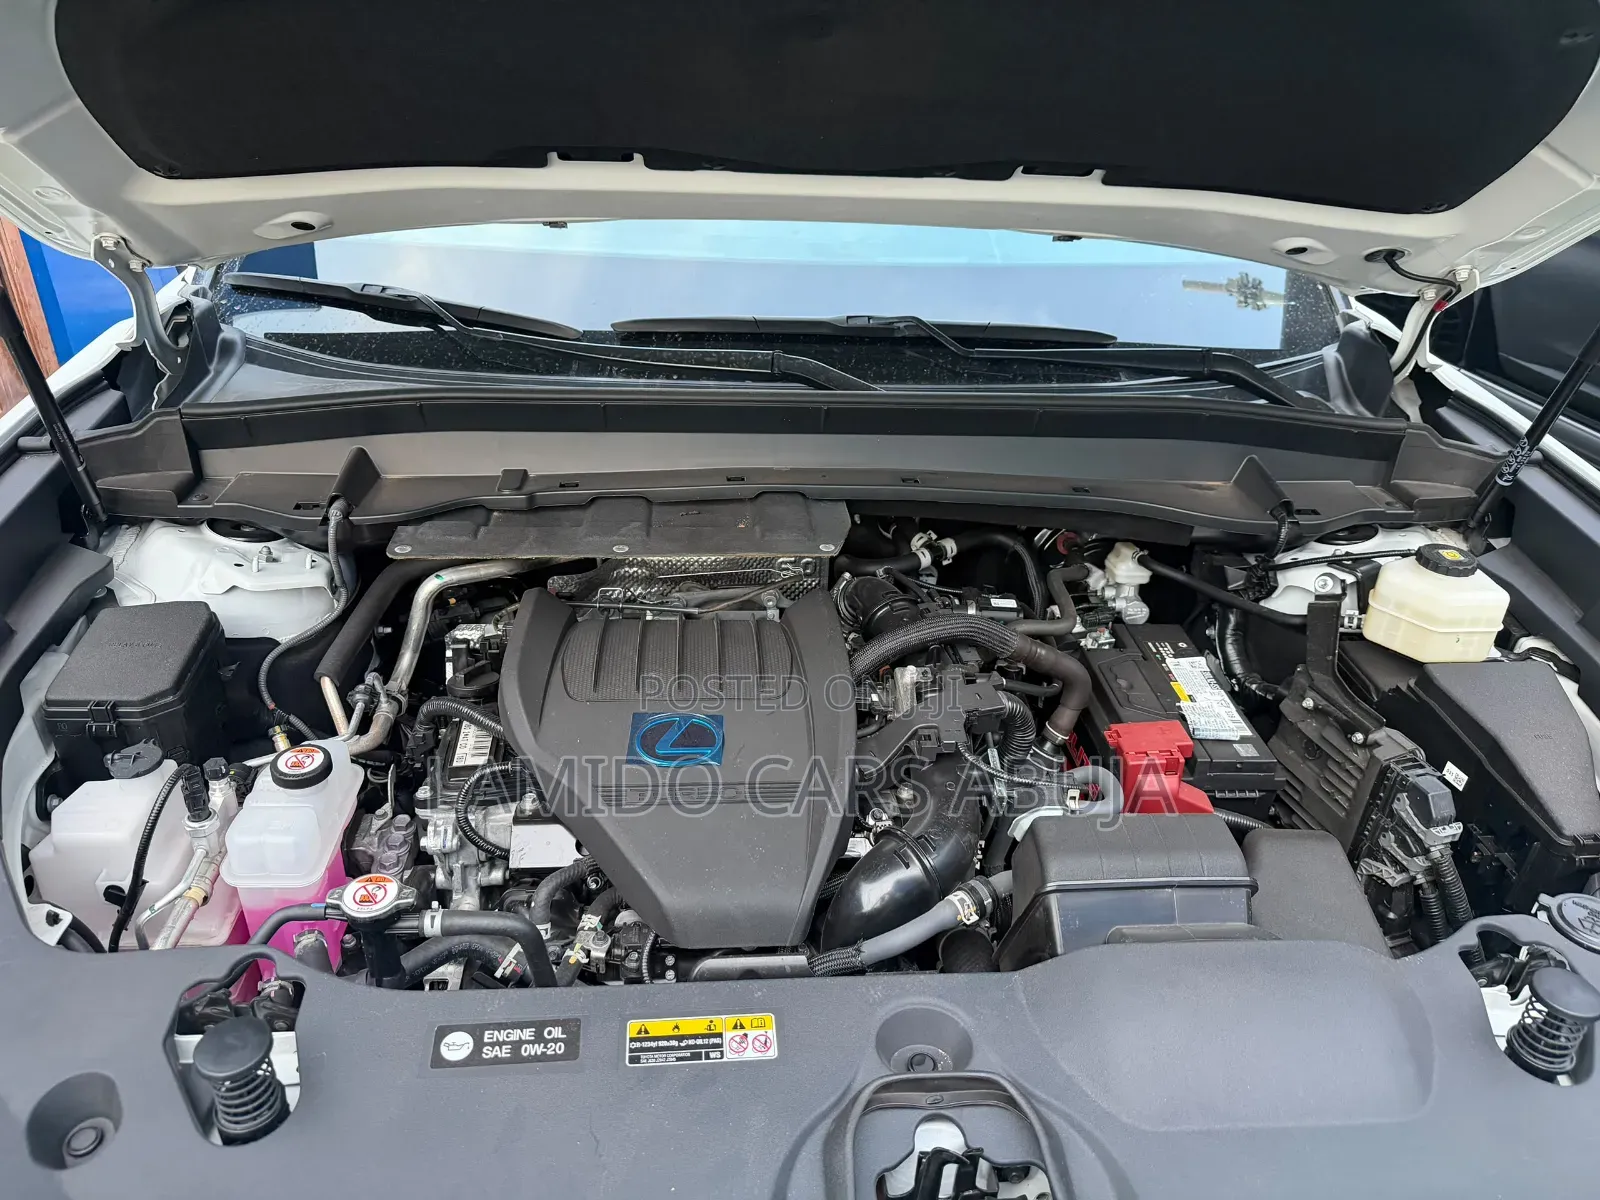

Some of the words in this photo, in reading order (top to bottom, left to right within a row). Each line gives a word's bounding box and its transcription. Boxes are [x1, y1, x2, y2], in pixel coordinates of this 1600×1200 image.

[484, 1028, 536, 1042] ENGINE
[543, 1026, 567, 1039] OIL
[481, 1045, 512, 1059] SAE
[521, 1042, 565, 1056] 0W-20
